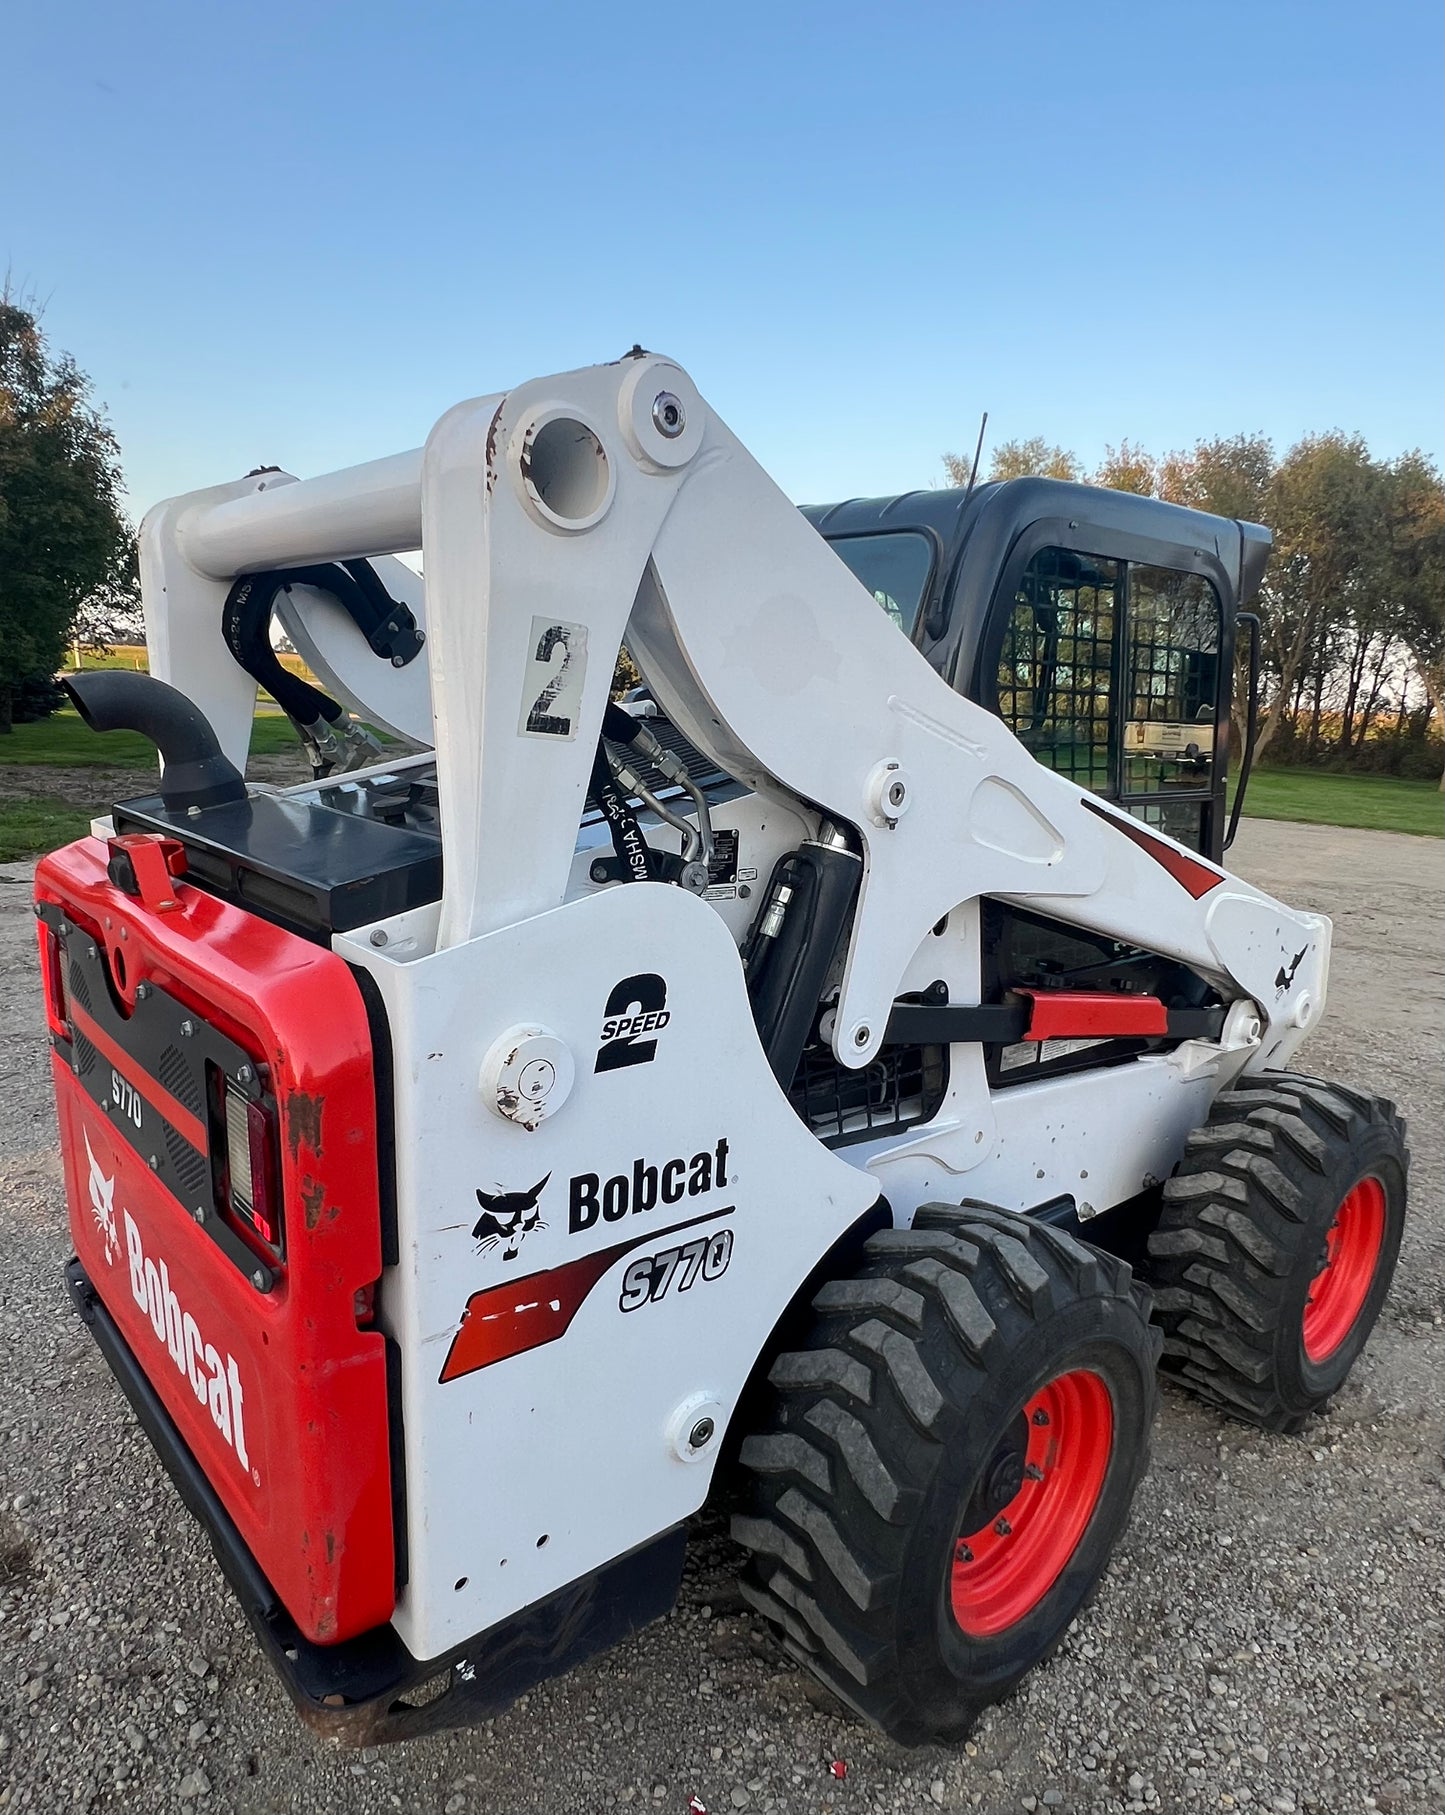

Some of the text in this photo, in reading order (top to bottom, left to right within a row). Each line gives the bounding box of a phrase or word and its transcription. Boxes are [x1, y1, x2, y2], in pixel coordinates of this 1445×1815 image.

[526, 625, 571, 735] 2
[623, 830, 648, 880] MSHA
[594, 973, 667, 1074] 2
[600, 1011, 671, 1041] SPEED
[111, 1069, 142, 1129] S770
[569, 1138, 729, 1235] Bobcat
[618, 1229, 734, 1313] S770
[123, 1207, 249, 1472] Bobcat
